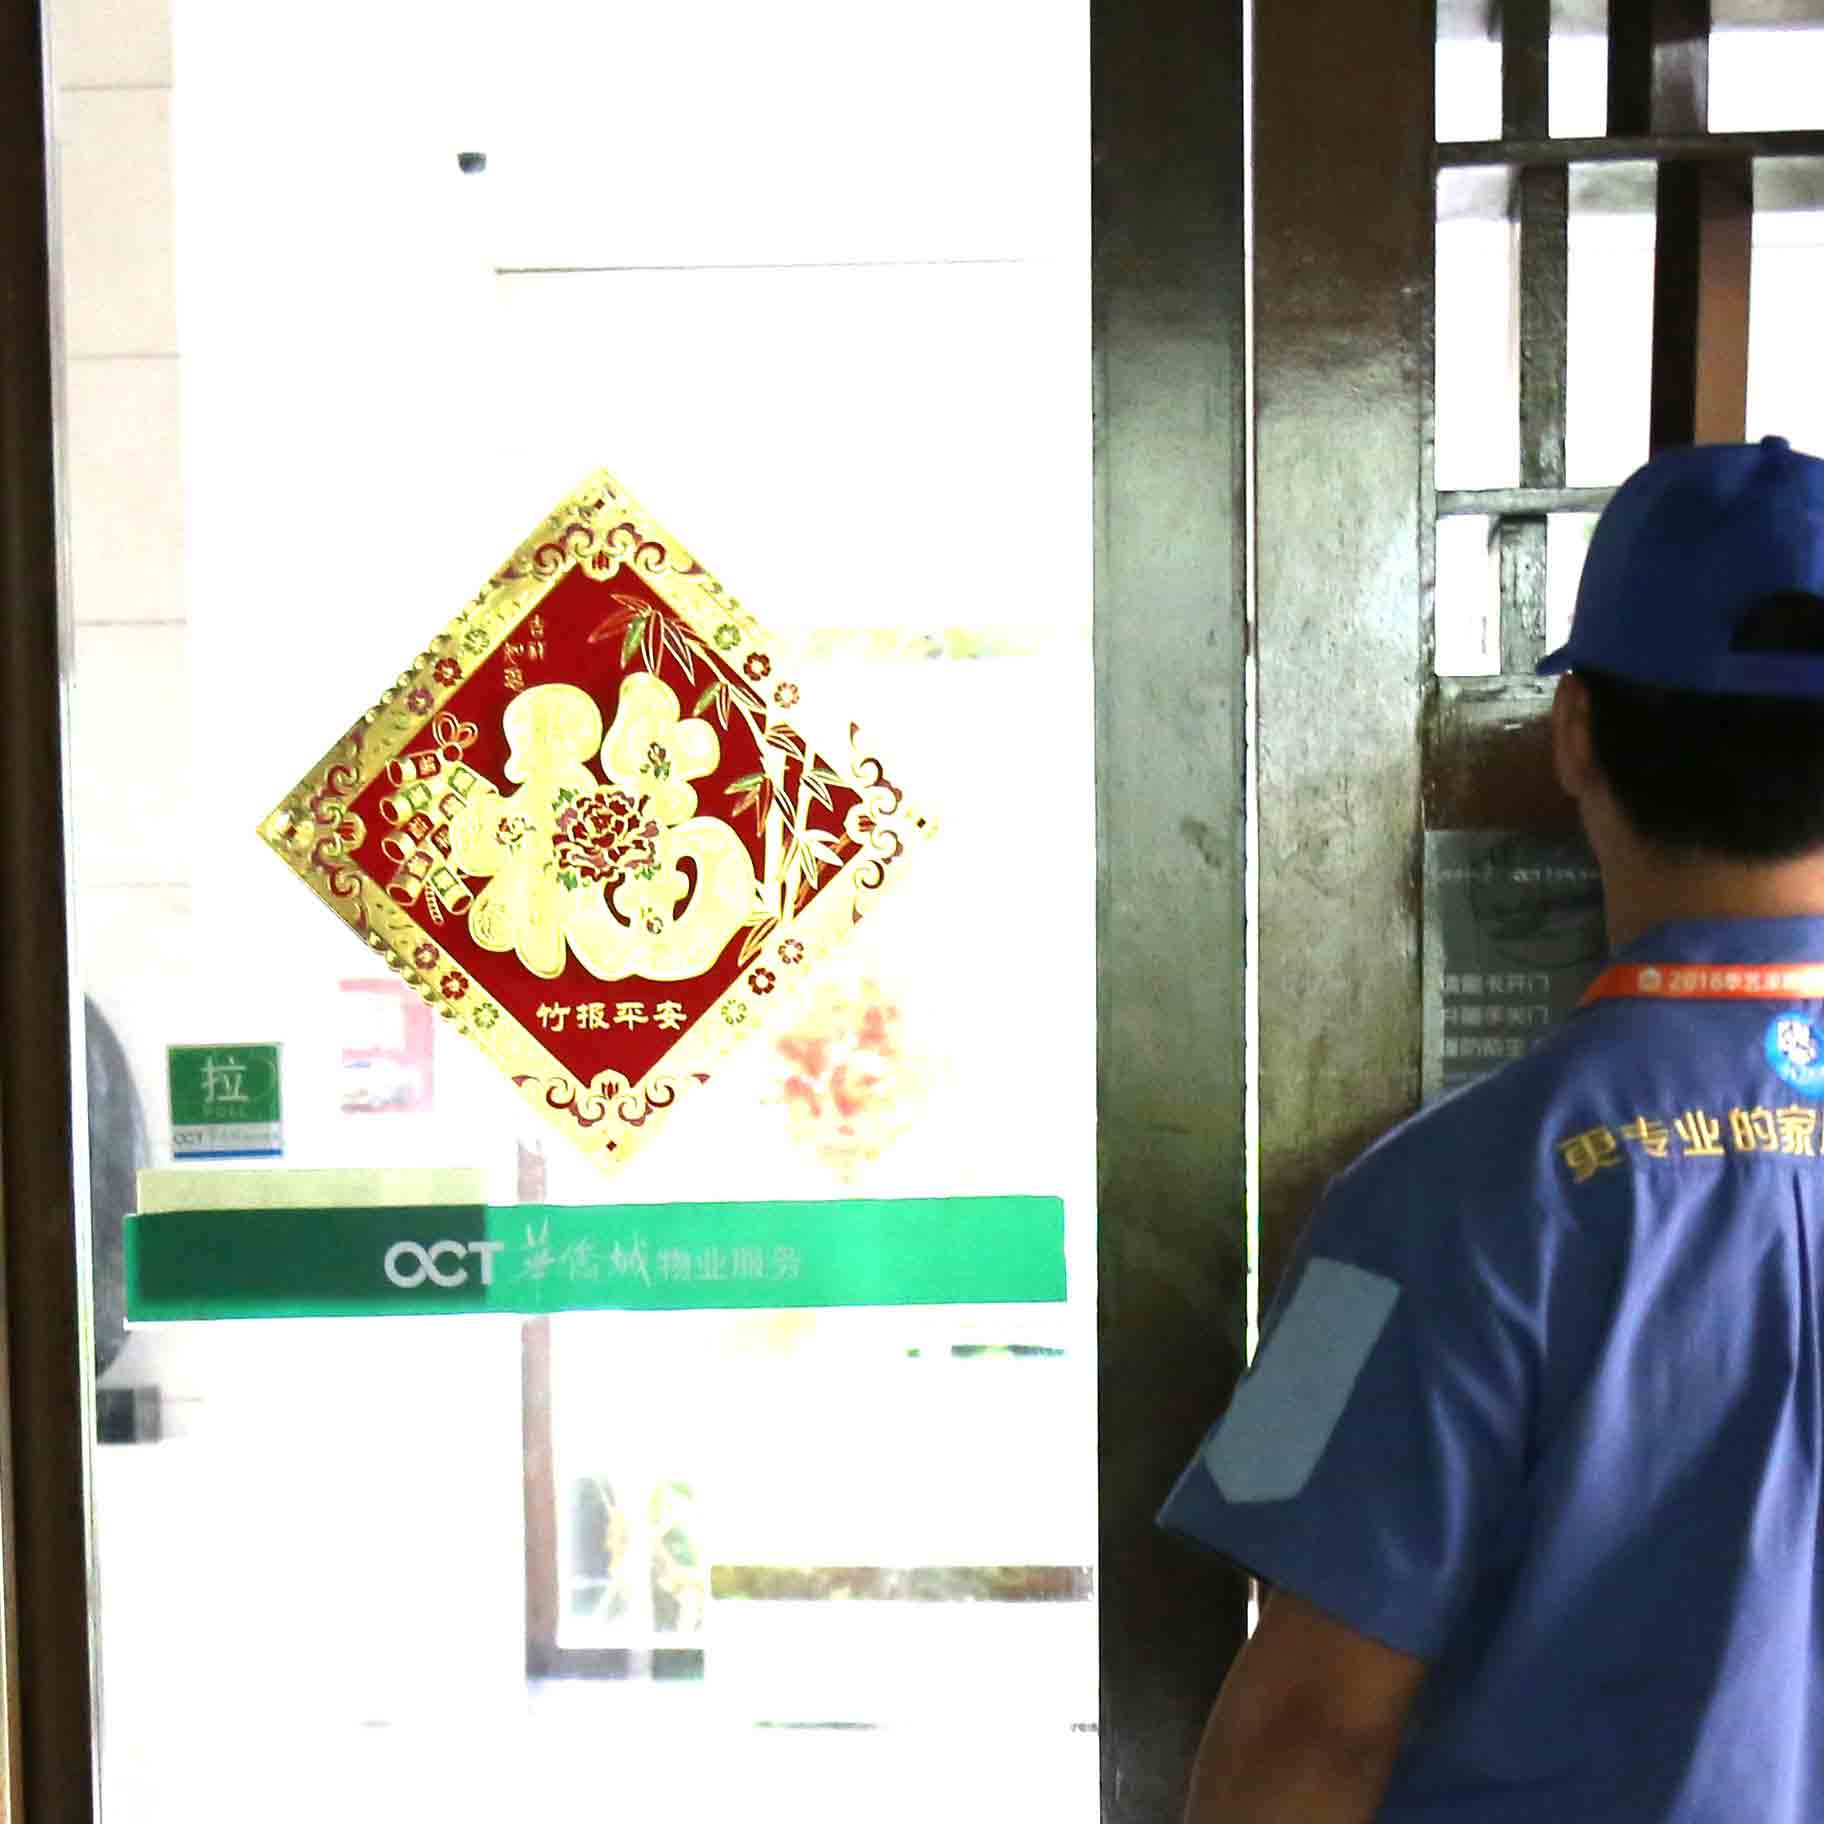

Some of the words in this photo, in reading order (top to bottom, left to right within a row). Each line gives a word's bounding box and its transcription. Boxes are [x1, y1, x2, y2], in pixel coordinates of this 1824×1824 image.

[448, 671, 756, 982] 福
[534, 999, 688, 1033] 竹报平安
[200, 1055, 250, 1104] 拉
[383, 1240, 505, 1289] OCT
